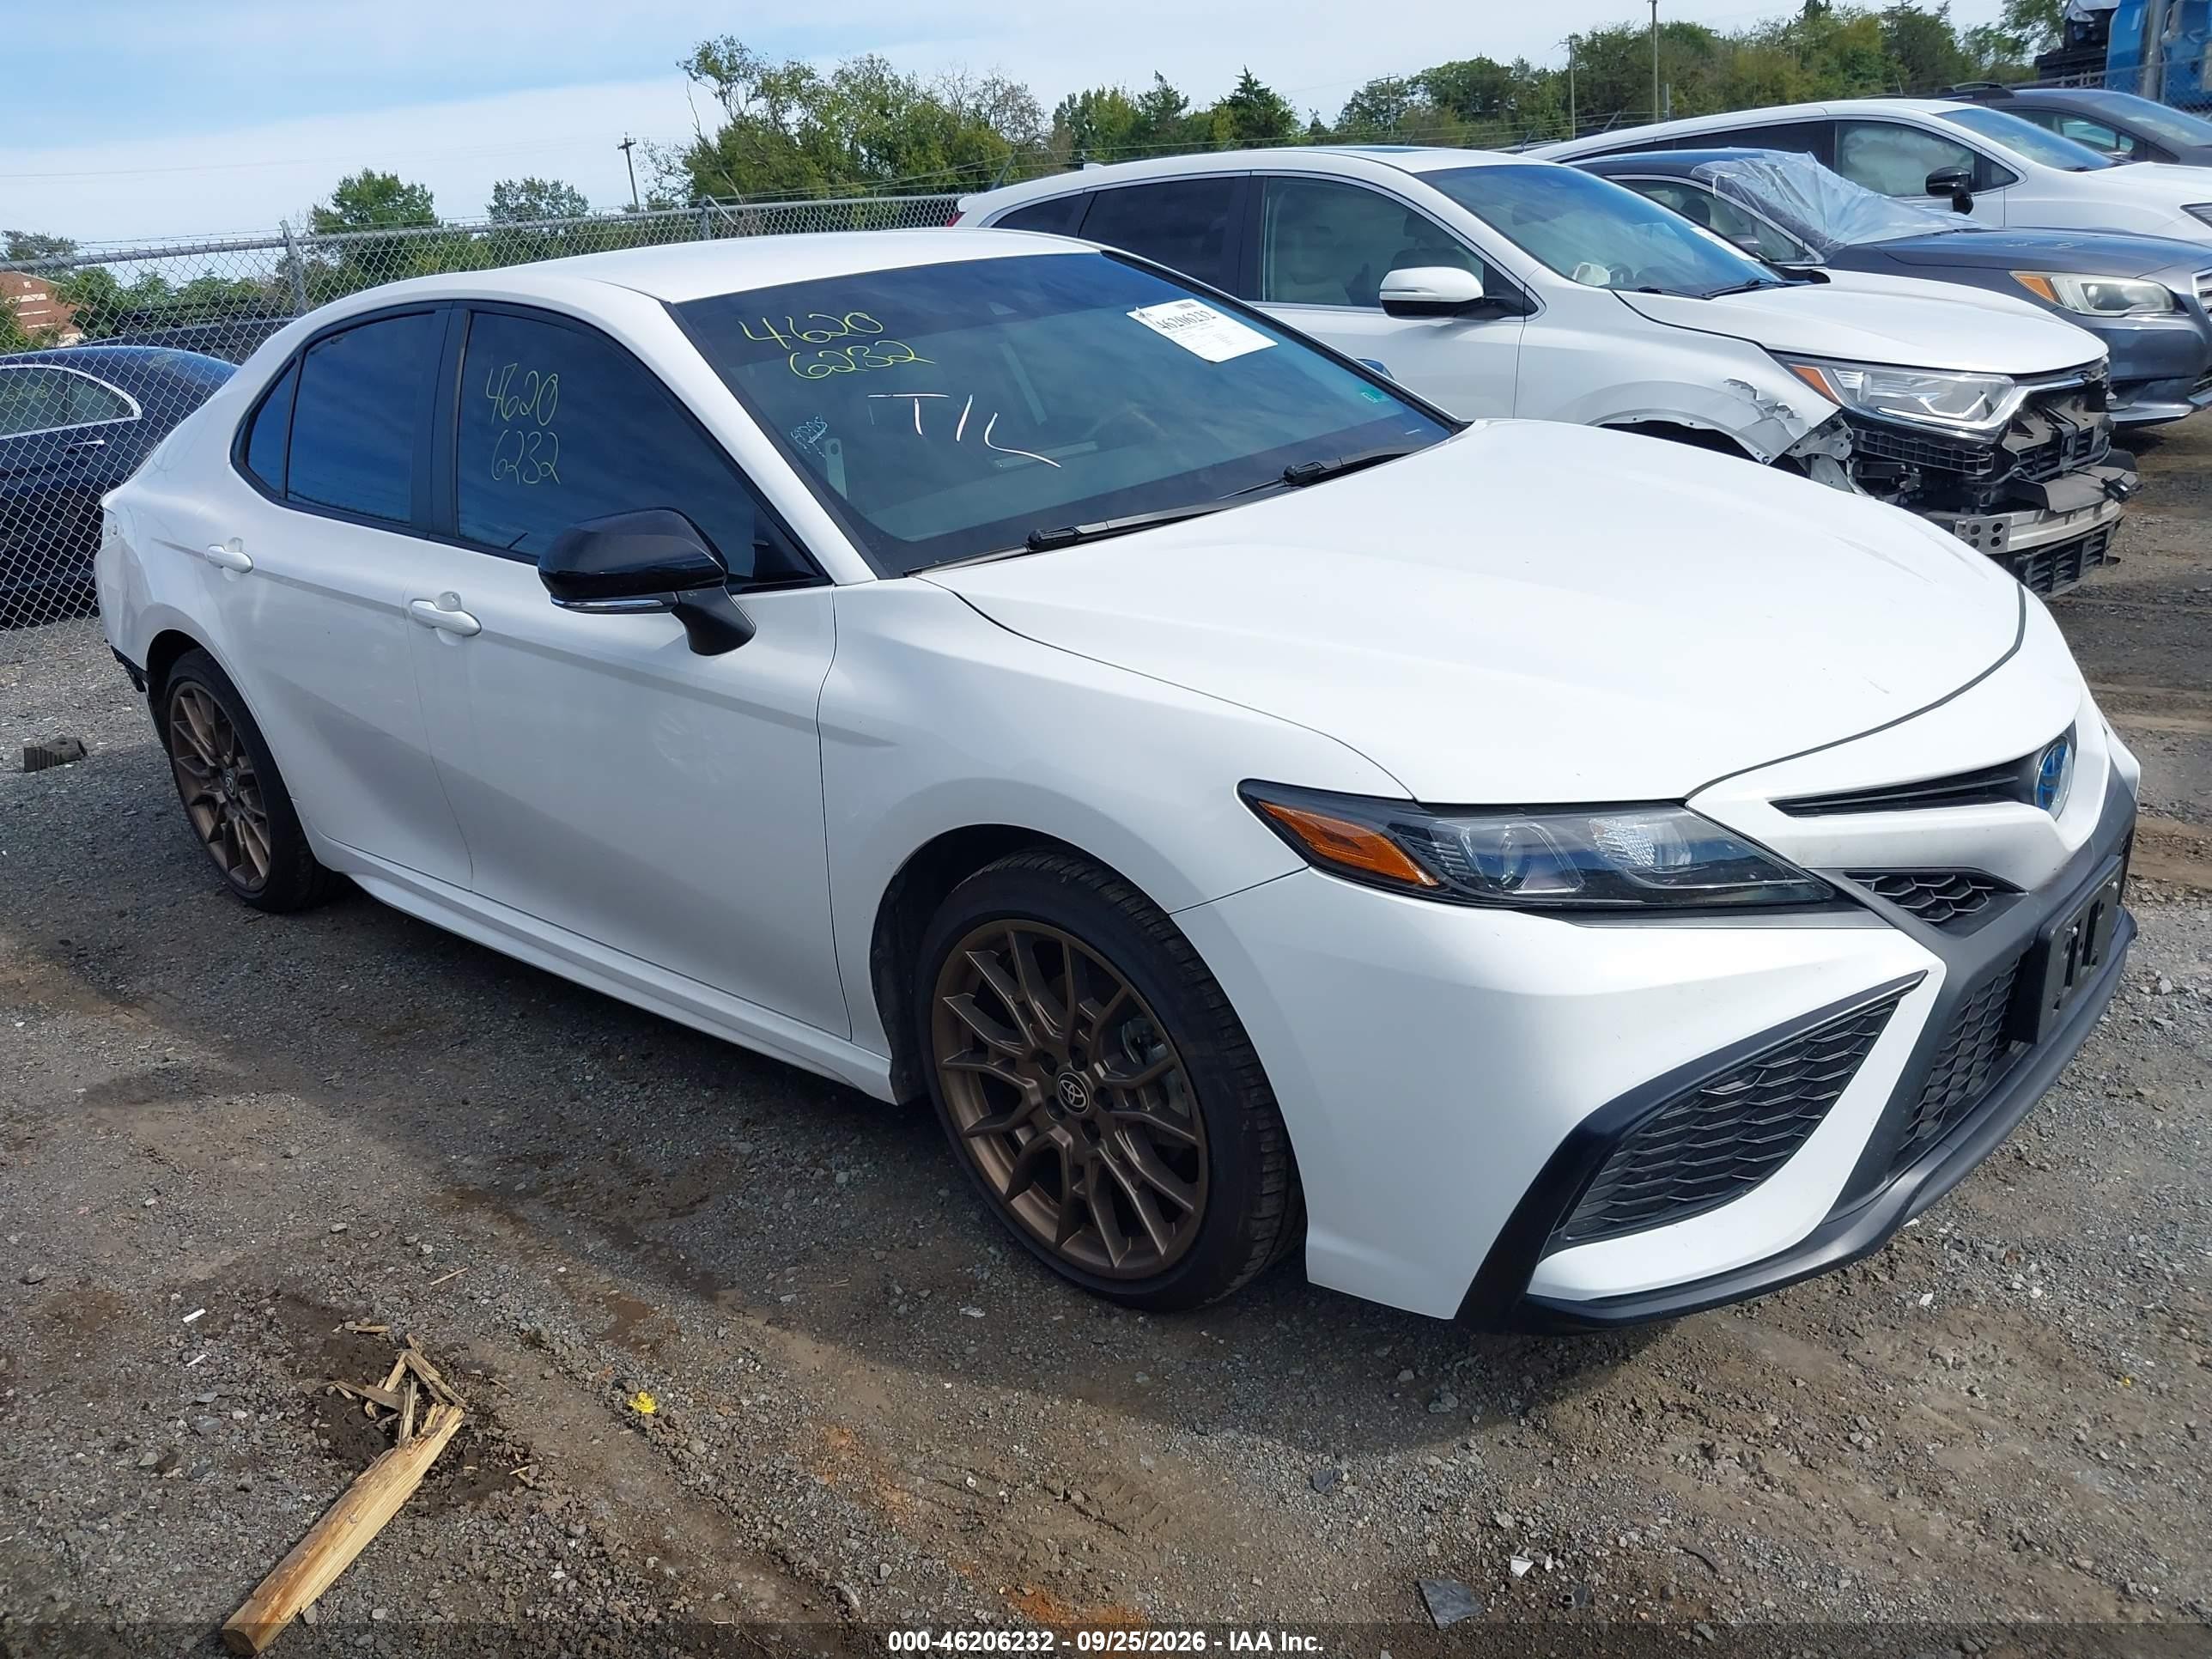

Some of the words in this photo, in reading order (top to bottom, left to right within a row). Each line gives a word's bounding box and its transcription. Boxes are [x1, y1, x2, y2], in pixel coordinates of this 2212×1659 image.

[738, 312, 884, 350] 4620
[1156, 310, 1217, 331] 46206232
[789, 340, 937, 380] 6232
[485, 362, 560, 427] 4620
[490, 429, 562, 486] 6232
